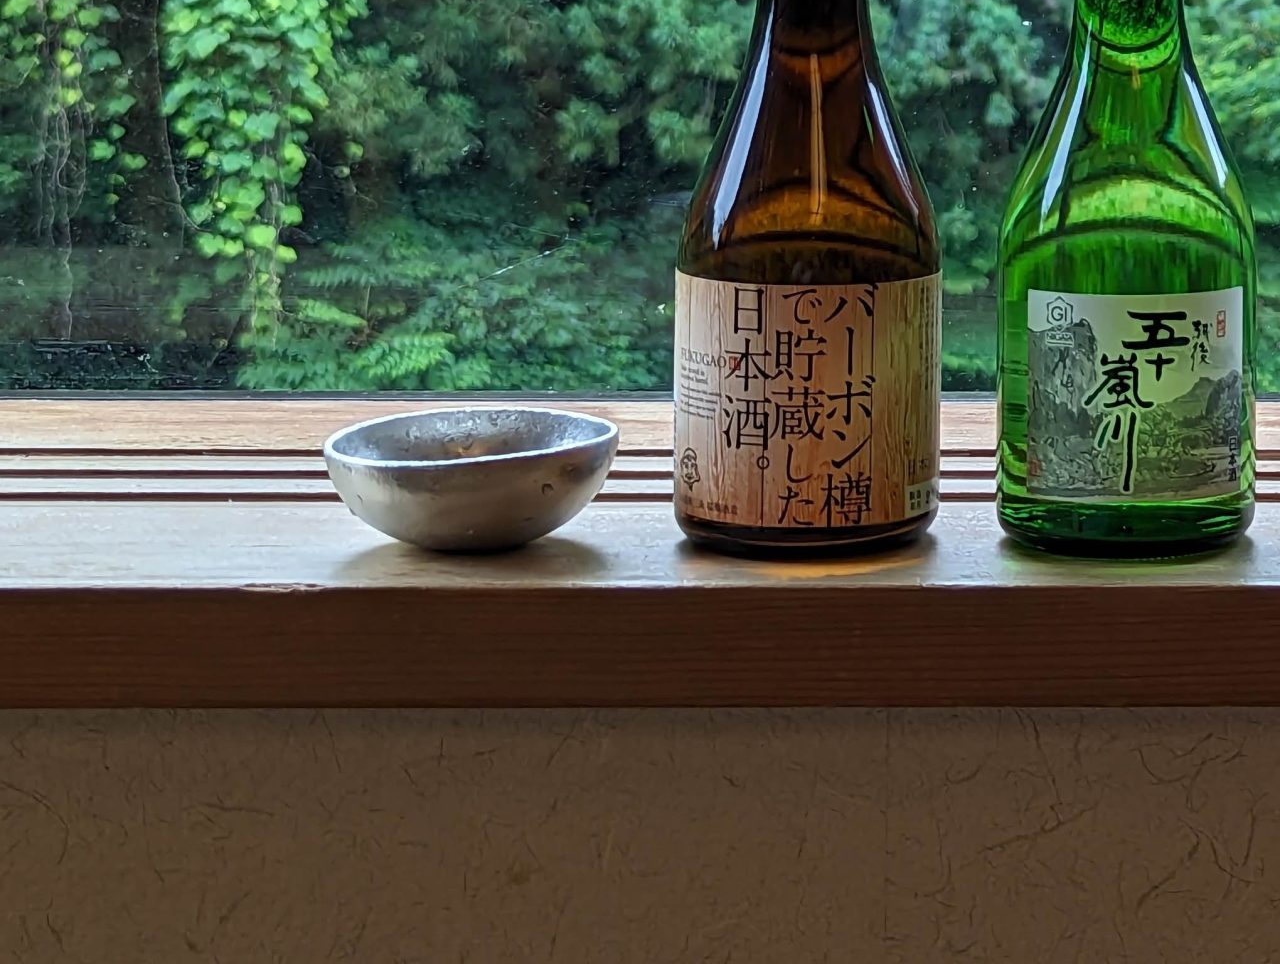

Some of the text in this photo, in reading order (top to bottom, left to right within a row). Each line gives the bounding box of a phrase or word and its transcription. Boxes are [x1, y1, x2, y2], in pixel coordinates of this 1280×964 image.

[770, 288, 828, 527] で貯蔵した
[821, 283, 879, 527] バーボン樽
[1050, 305, 1068, 322] GI
